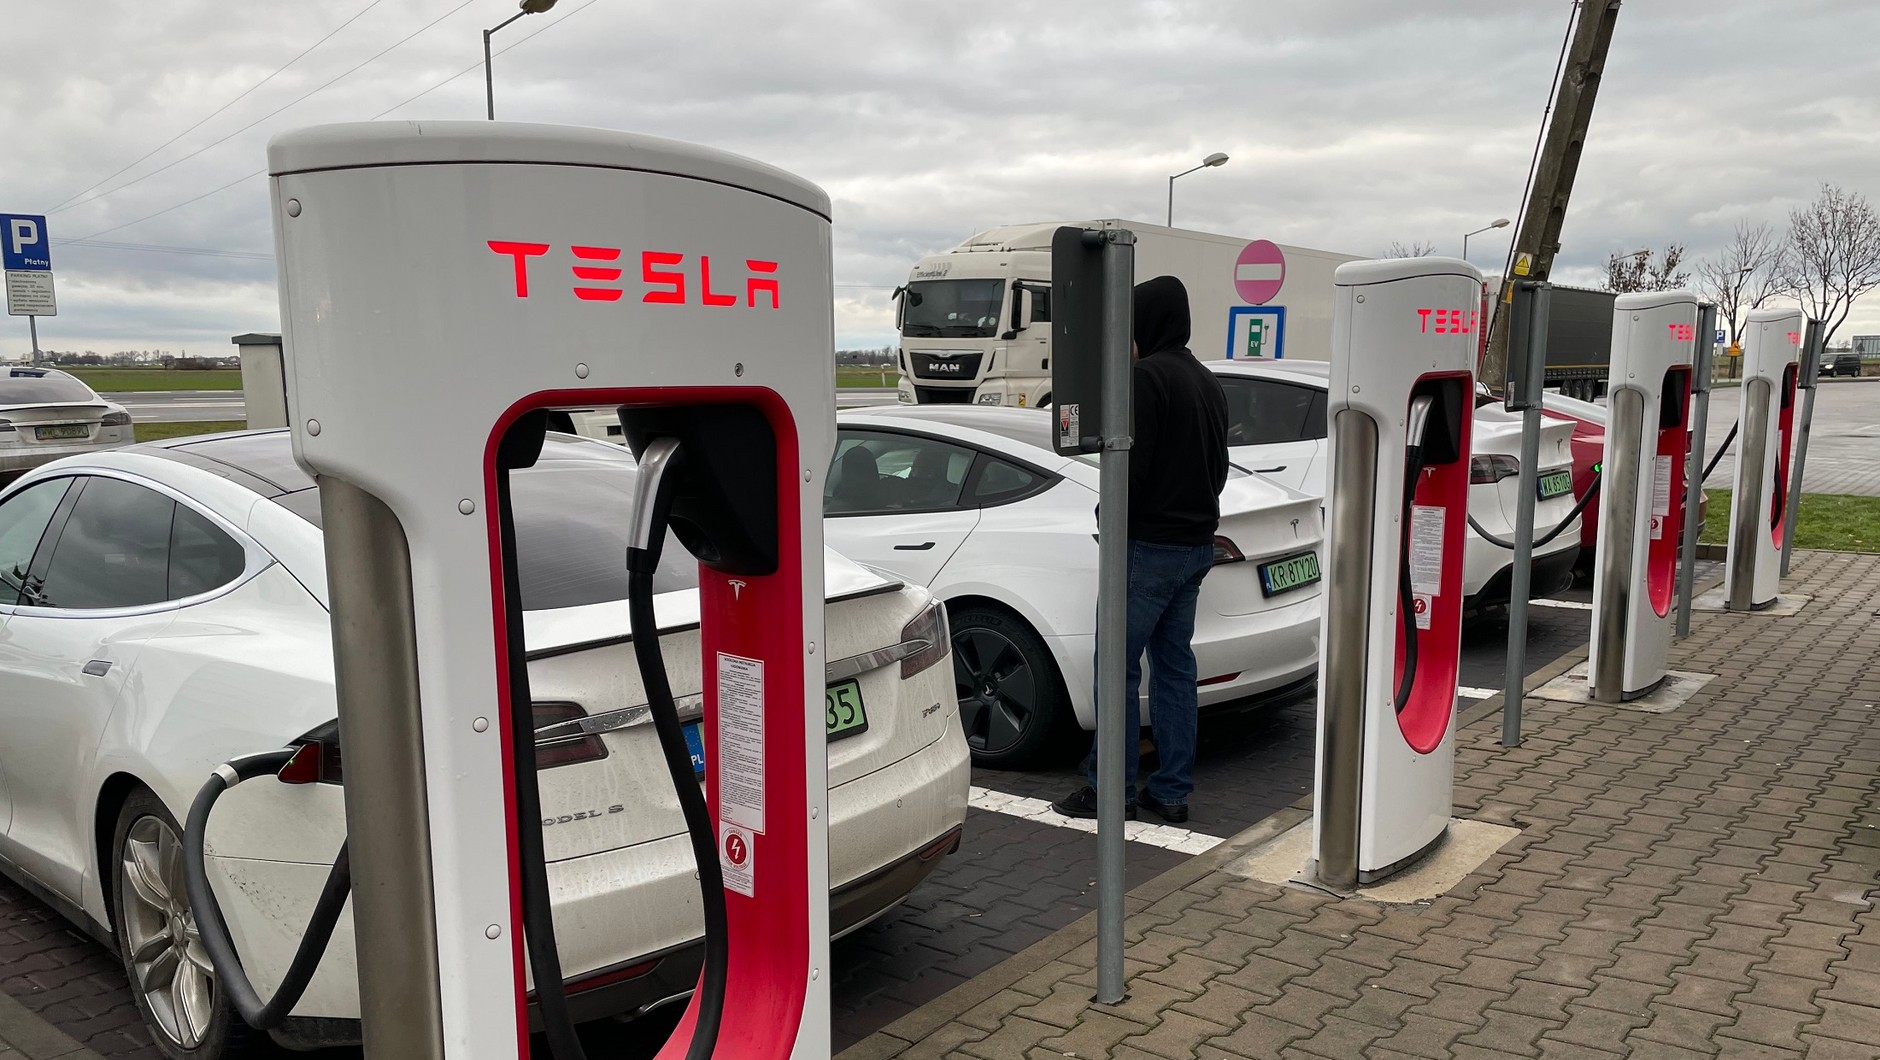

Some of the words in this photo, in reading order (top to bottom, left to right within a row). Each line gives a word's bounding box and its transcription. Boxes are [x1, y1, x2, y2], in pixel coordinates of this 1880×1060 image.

[11, 219, 38, 254] P
[24, 258, 49, 267] Płatny
[487, 240, 779, 309] TESLA
[1716, 331, 1724, 340] P
[1250, 340, 1259, 348] EV
[929, 363, 960, 372] MAN
[1270, 565, 1288, 589] KR
[1288, 556, 1317, 583] 8TY20
[690, 753, 704, 766] PL
[541, 809, 602, 826] ODEL
[608, 804, 624, 814] S
